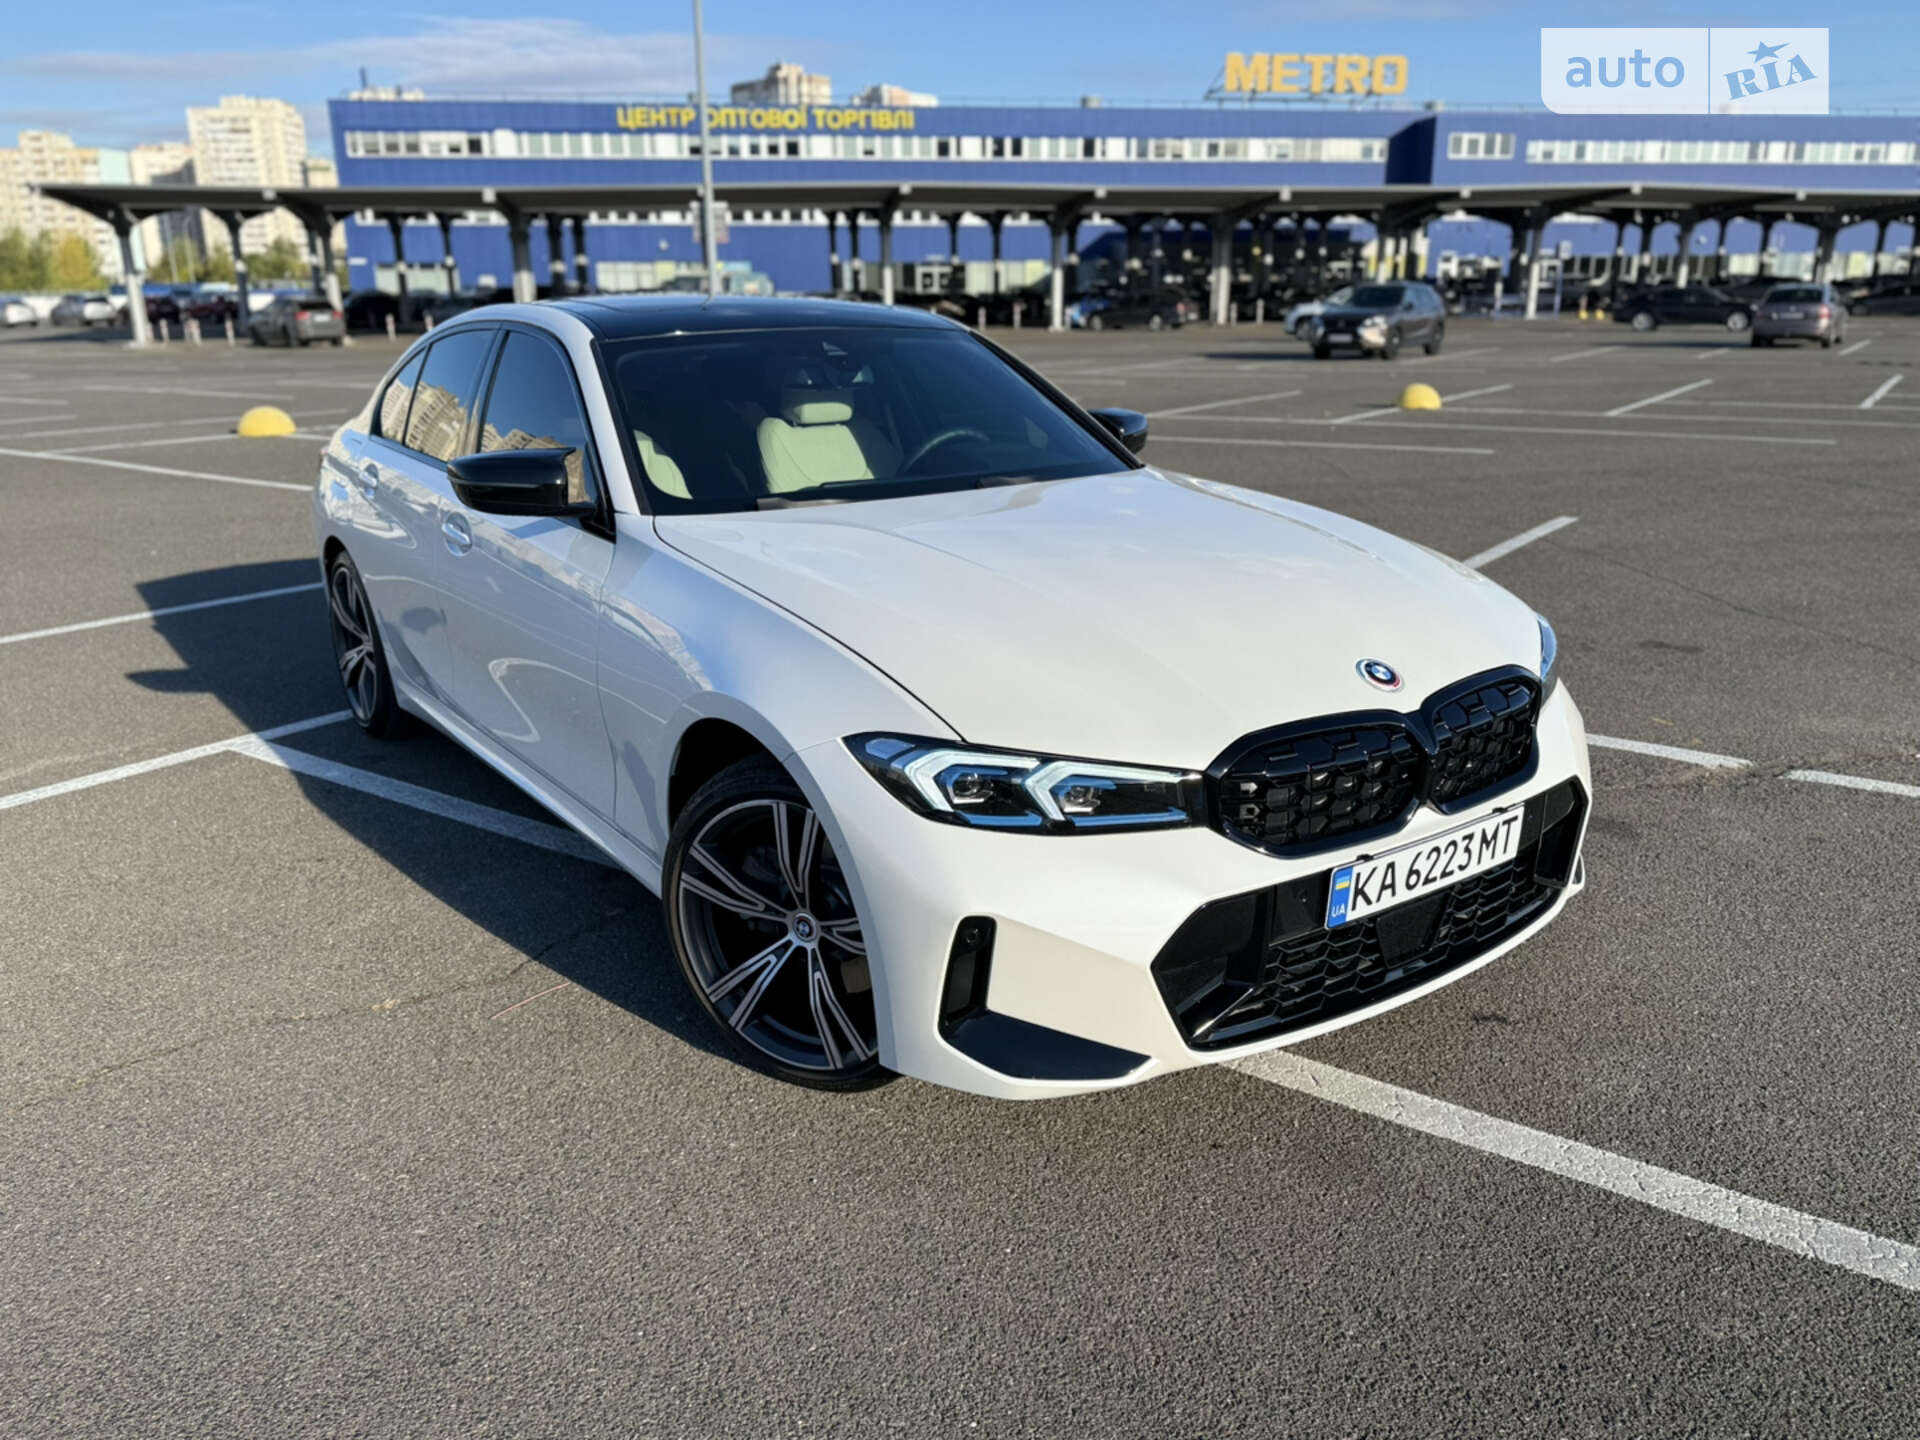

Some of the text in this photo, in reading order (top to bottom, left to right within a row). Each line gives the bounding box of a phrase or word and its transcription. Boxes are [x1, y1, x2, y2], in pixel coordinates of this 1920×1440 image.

[1225, 52, 1408, 94] METRO
[616, 106, 697, 131] ЦЕНТР
[812, 108, 915, 130] ТОРГІВЛІ
[1331, 903, 1346, 918] UA
